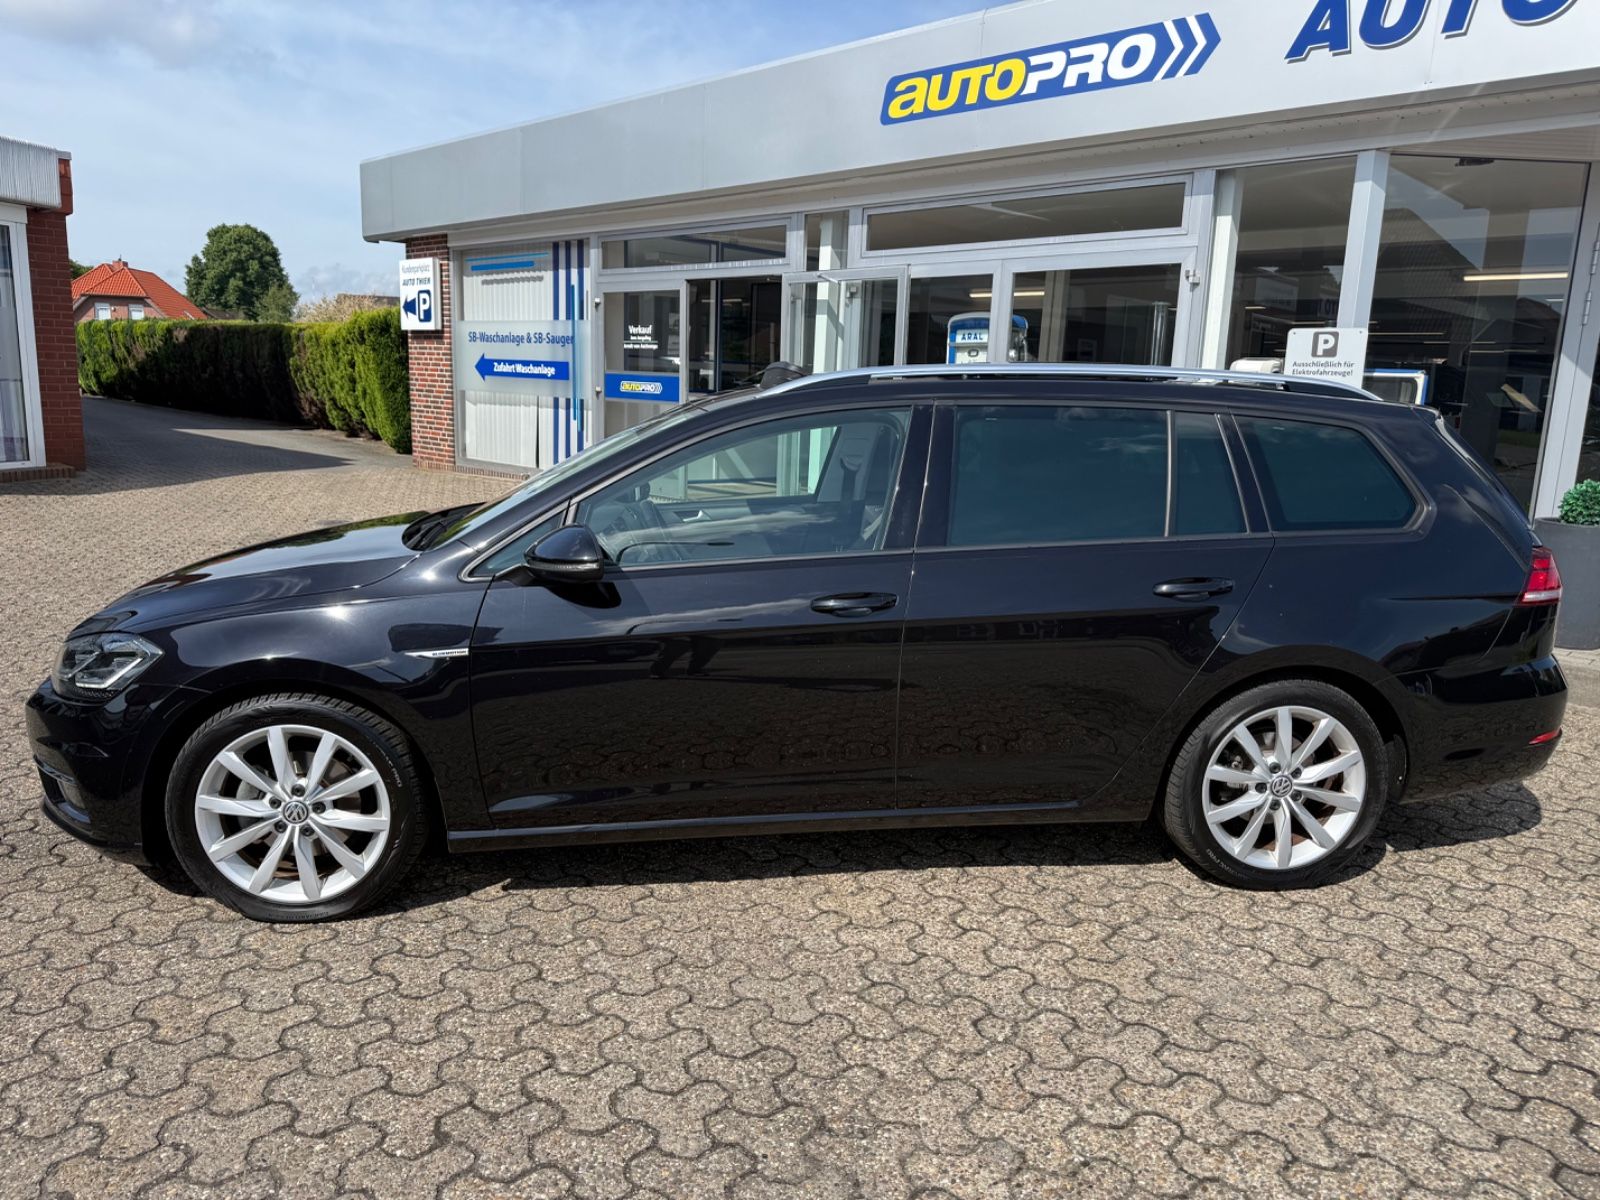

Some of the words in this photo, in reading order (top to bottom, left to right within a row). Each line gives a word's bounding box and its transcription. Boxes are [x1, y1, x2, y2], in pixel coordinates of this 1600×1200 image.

[1284, 0, 1578, 63] AU
[419, 293, 430, 320] P
[628, 324, 652, 335] Verkauf
[961, 331, 983, 341] ARAL
[468, 331, 525, 346] SB-Waschanlage
[526, 332, 532, 344] &
[1316, 334, 1335, 356] P
[493, 362, 515, 373] Zufahrt
[516, 363, 556, 377] Waschanlage
[1292, 360, 1342, 368] Ausschließlich
[1343, 360, 1355, 368] für
